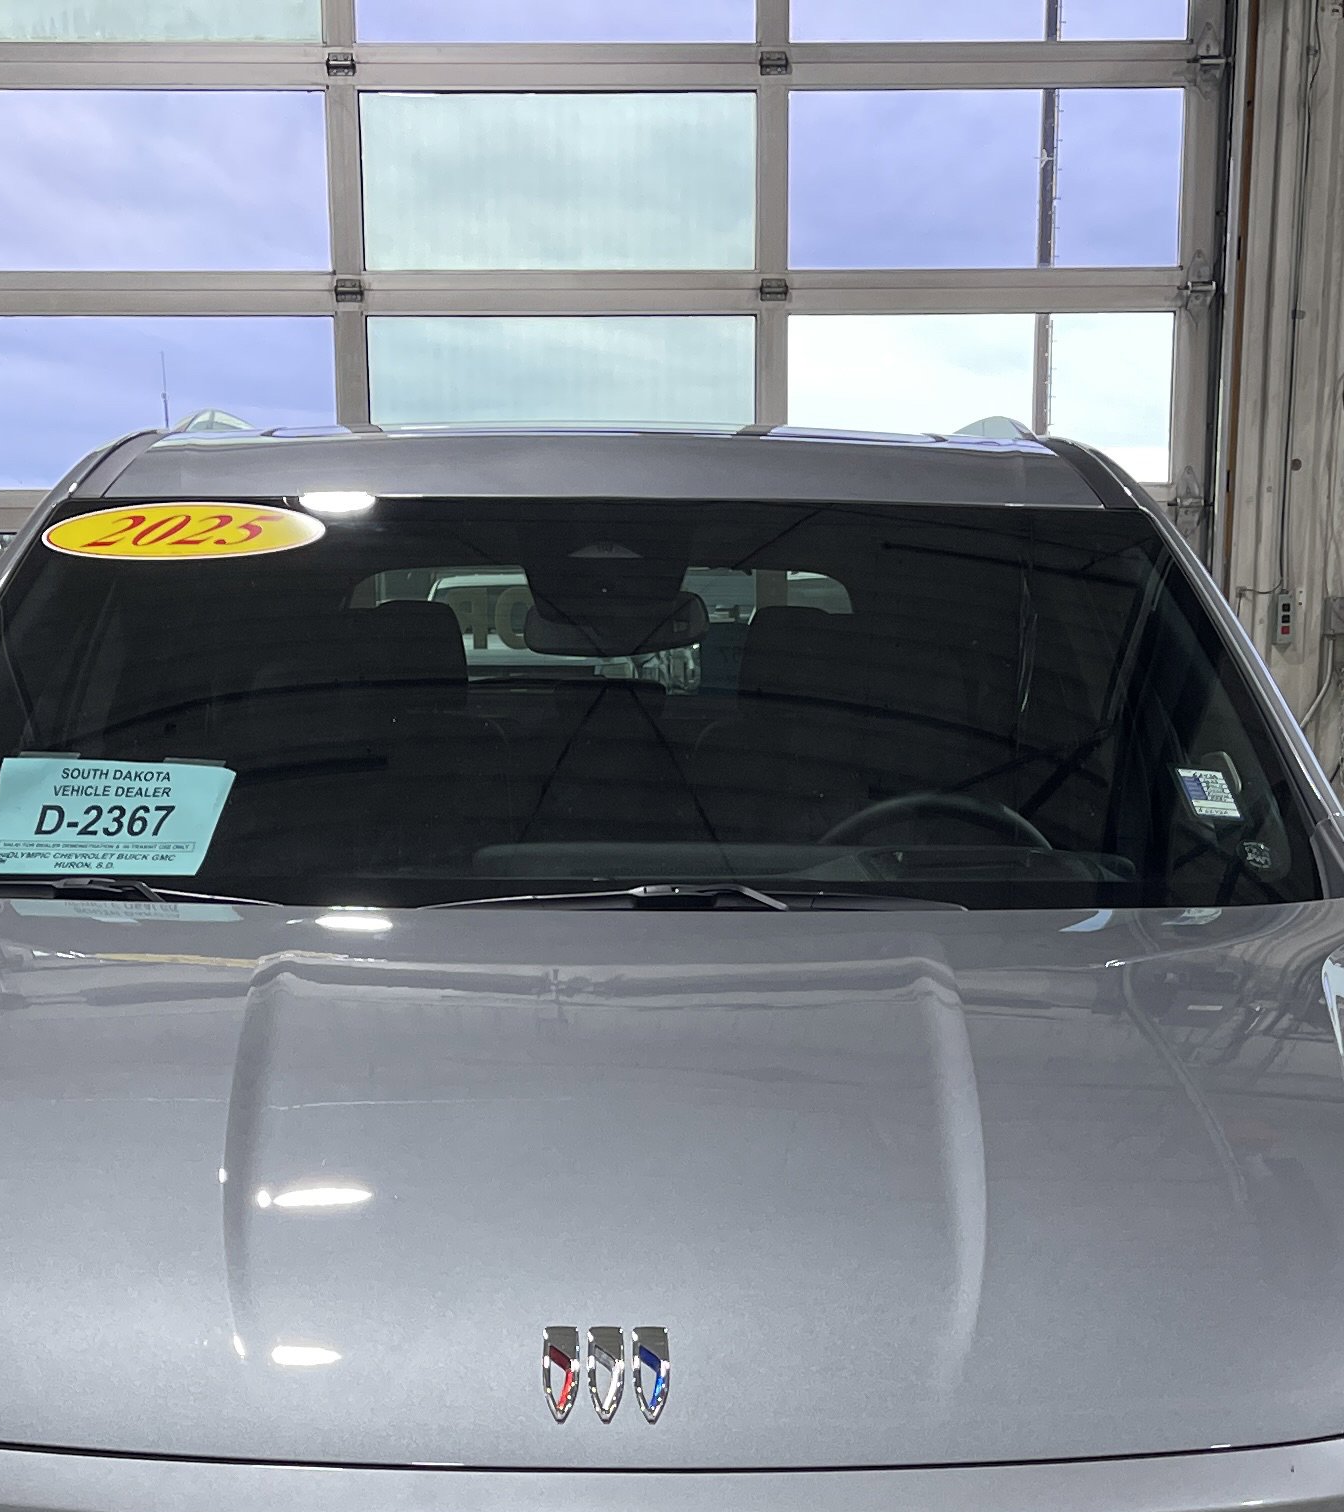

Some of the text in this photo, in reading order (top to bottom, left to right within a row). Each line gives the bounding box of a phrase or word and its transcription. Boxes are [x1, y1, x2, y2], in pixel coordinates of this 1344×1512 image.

[79, 514, 284, 548] 2025
[61, 768, 171, 782] SOUTH DAKOTA
[53, 784, 172, 798] VEHICLE DEALER
[34, 804, 176, 837] D-2367
[7, 851, 51, 859] OLYMPIC
[52, 852, 116, 860] CHEVROLET
[116, 853, 150, 861] BUICK
